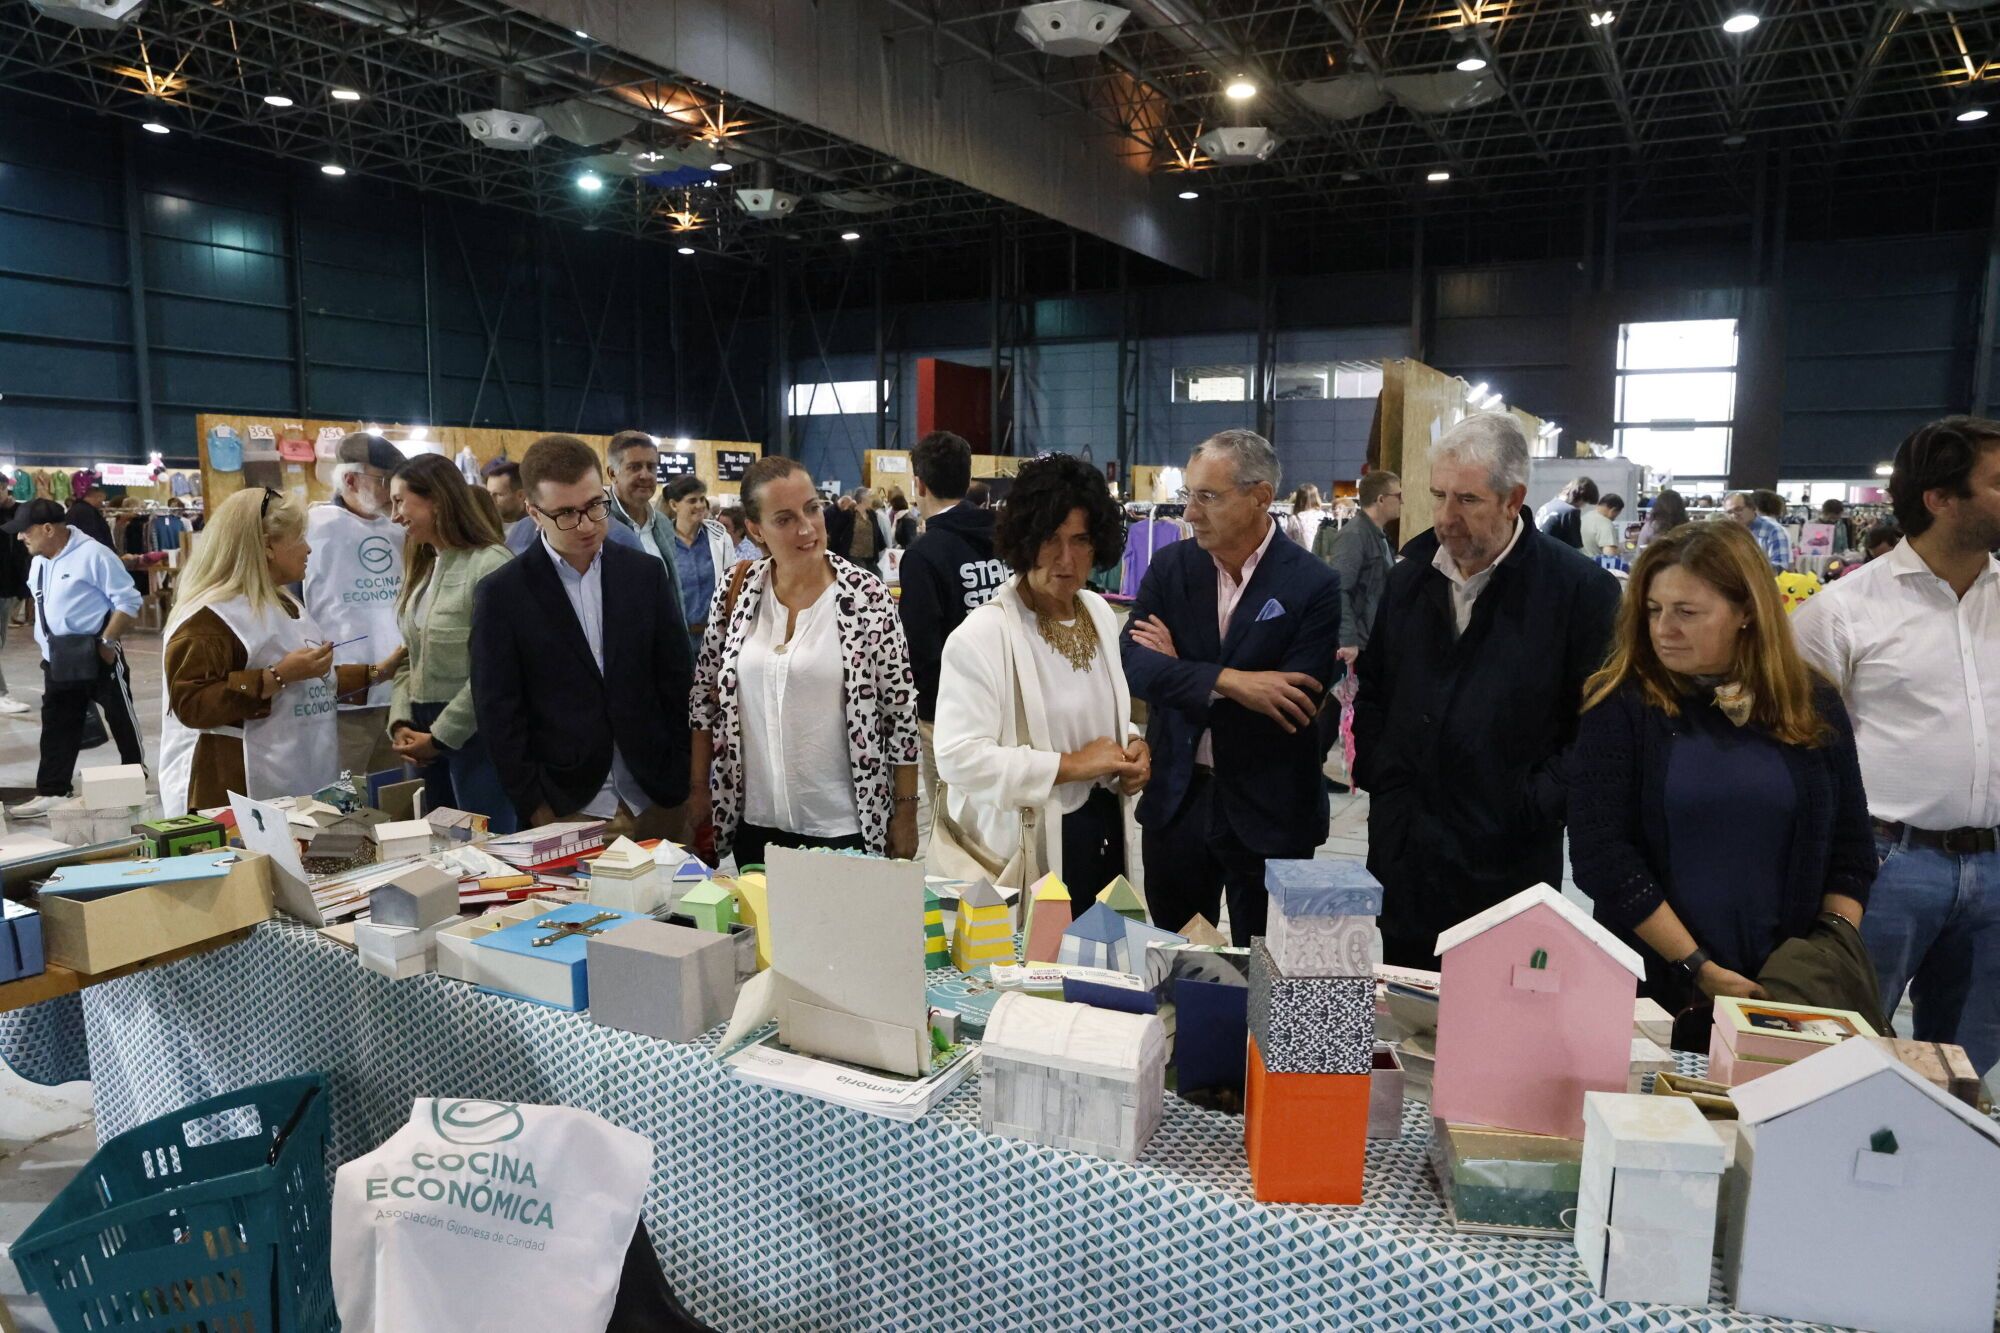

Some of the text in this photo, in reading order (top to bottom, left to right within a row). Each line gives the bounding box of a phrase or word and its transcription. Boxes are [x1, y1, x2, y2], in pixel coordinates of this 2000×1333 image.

[250, 426, 274, 438] 35€
[355, 576, 401, 589] COCINA
[309, 685, 330, 699] COCI
[836, 1075, 906, 1094] Memoria
[412, 1151, 537, 1189] COCINA
[366, 1176, 554, 1230] ECONÓMICA
[375, 1208, 547, 1252] Asociación Gijonesa de Caridad
